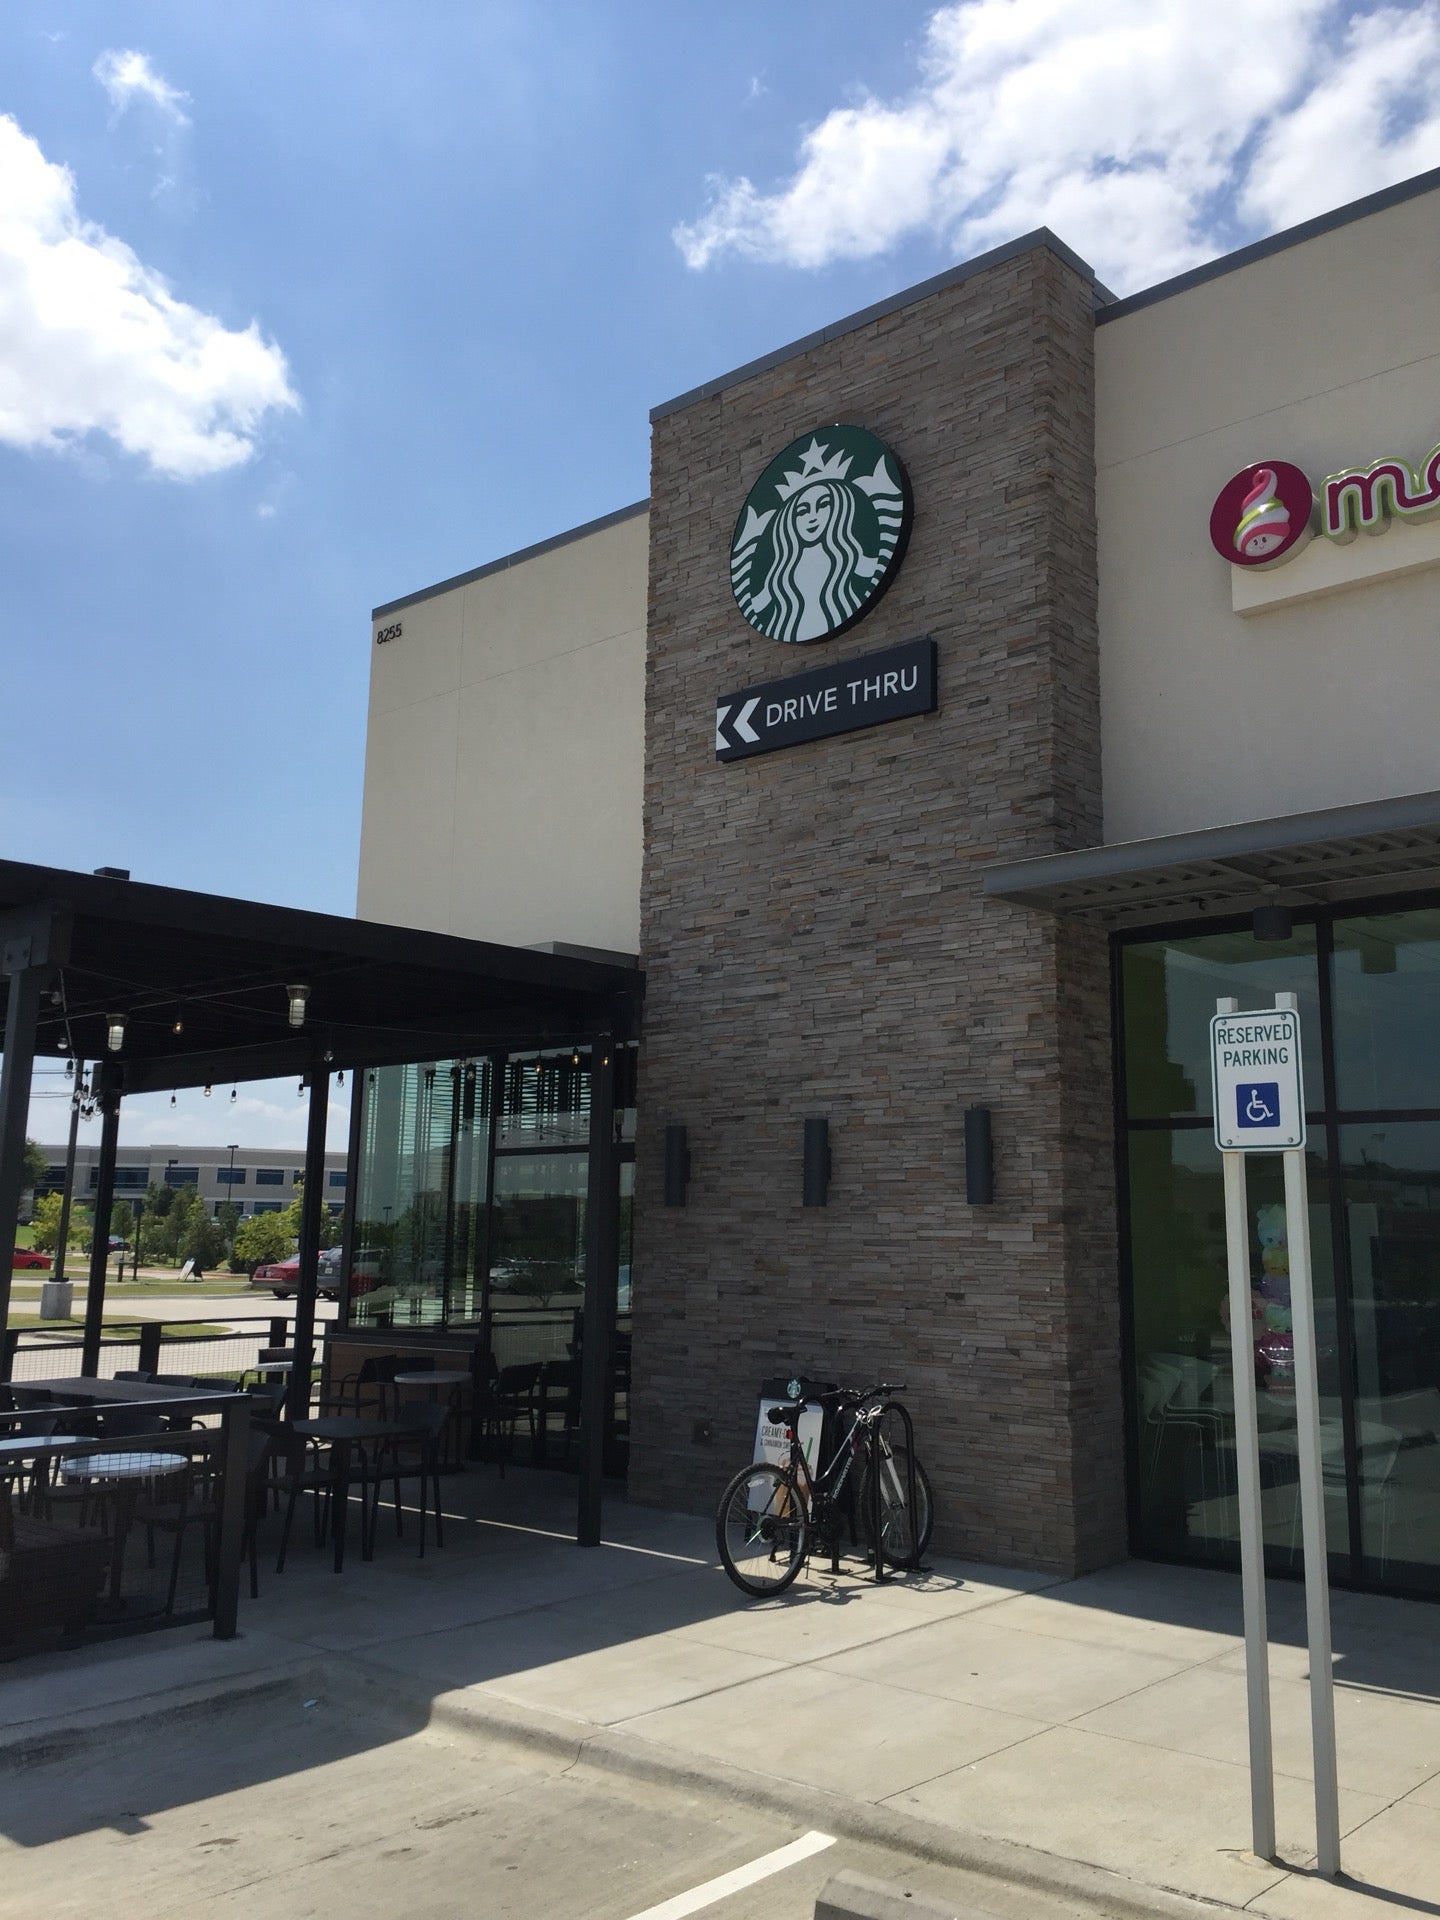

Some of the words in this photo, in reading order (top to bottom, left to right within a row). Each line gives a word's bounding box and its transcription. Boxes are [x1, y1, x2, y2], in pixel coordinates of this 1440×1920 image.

[377, 623, 402, 645] 8255
[766, 687, 837, 727] DRIVE
[847, 665, 918, 705] THRU
[1217, 1023, 1293, 1045] RESERVED
[1223, 1047, 1289, 1067] PARKING
